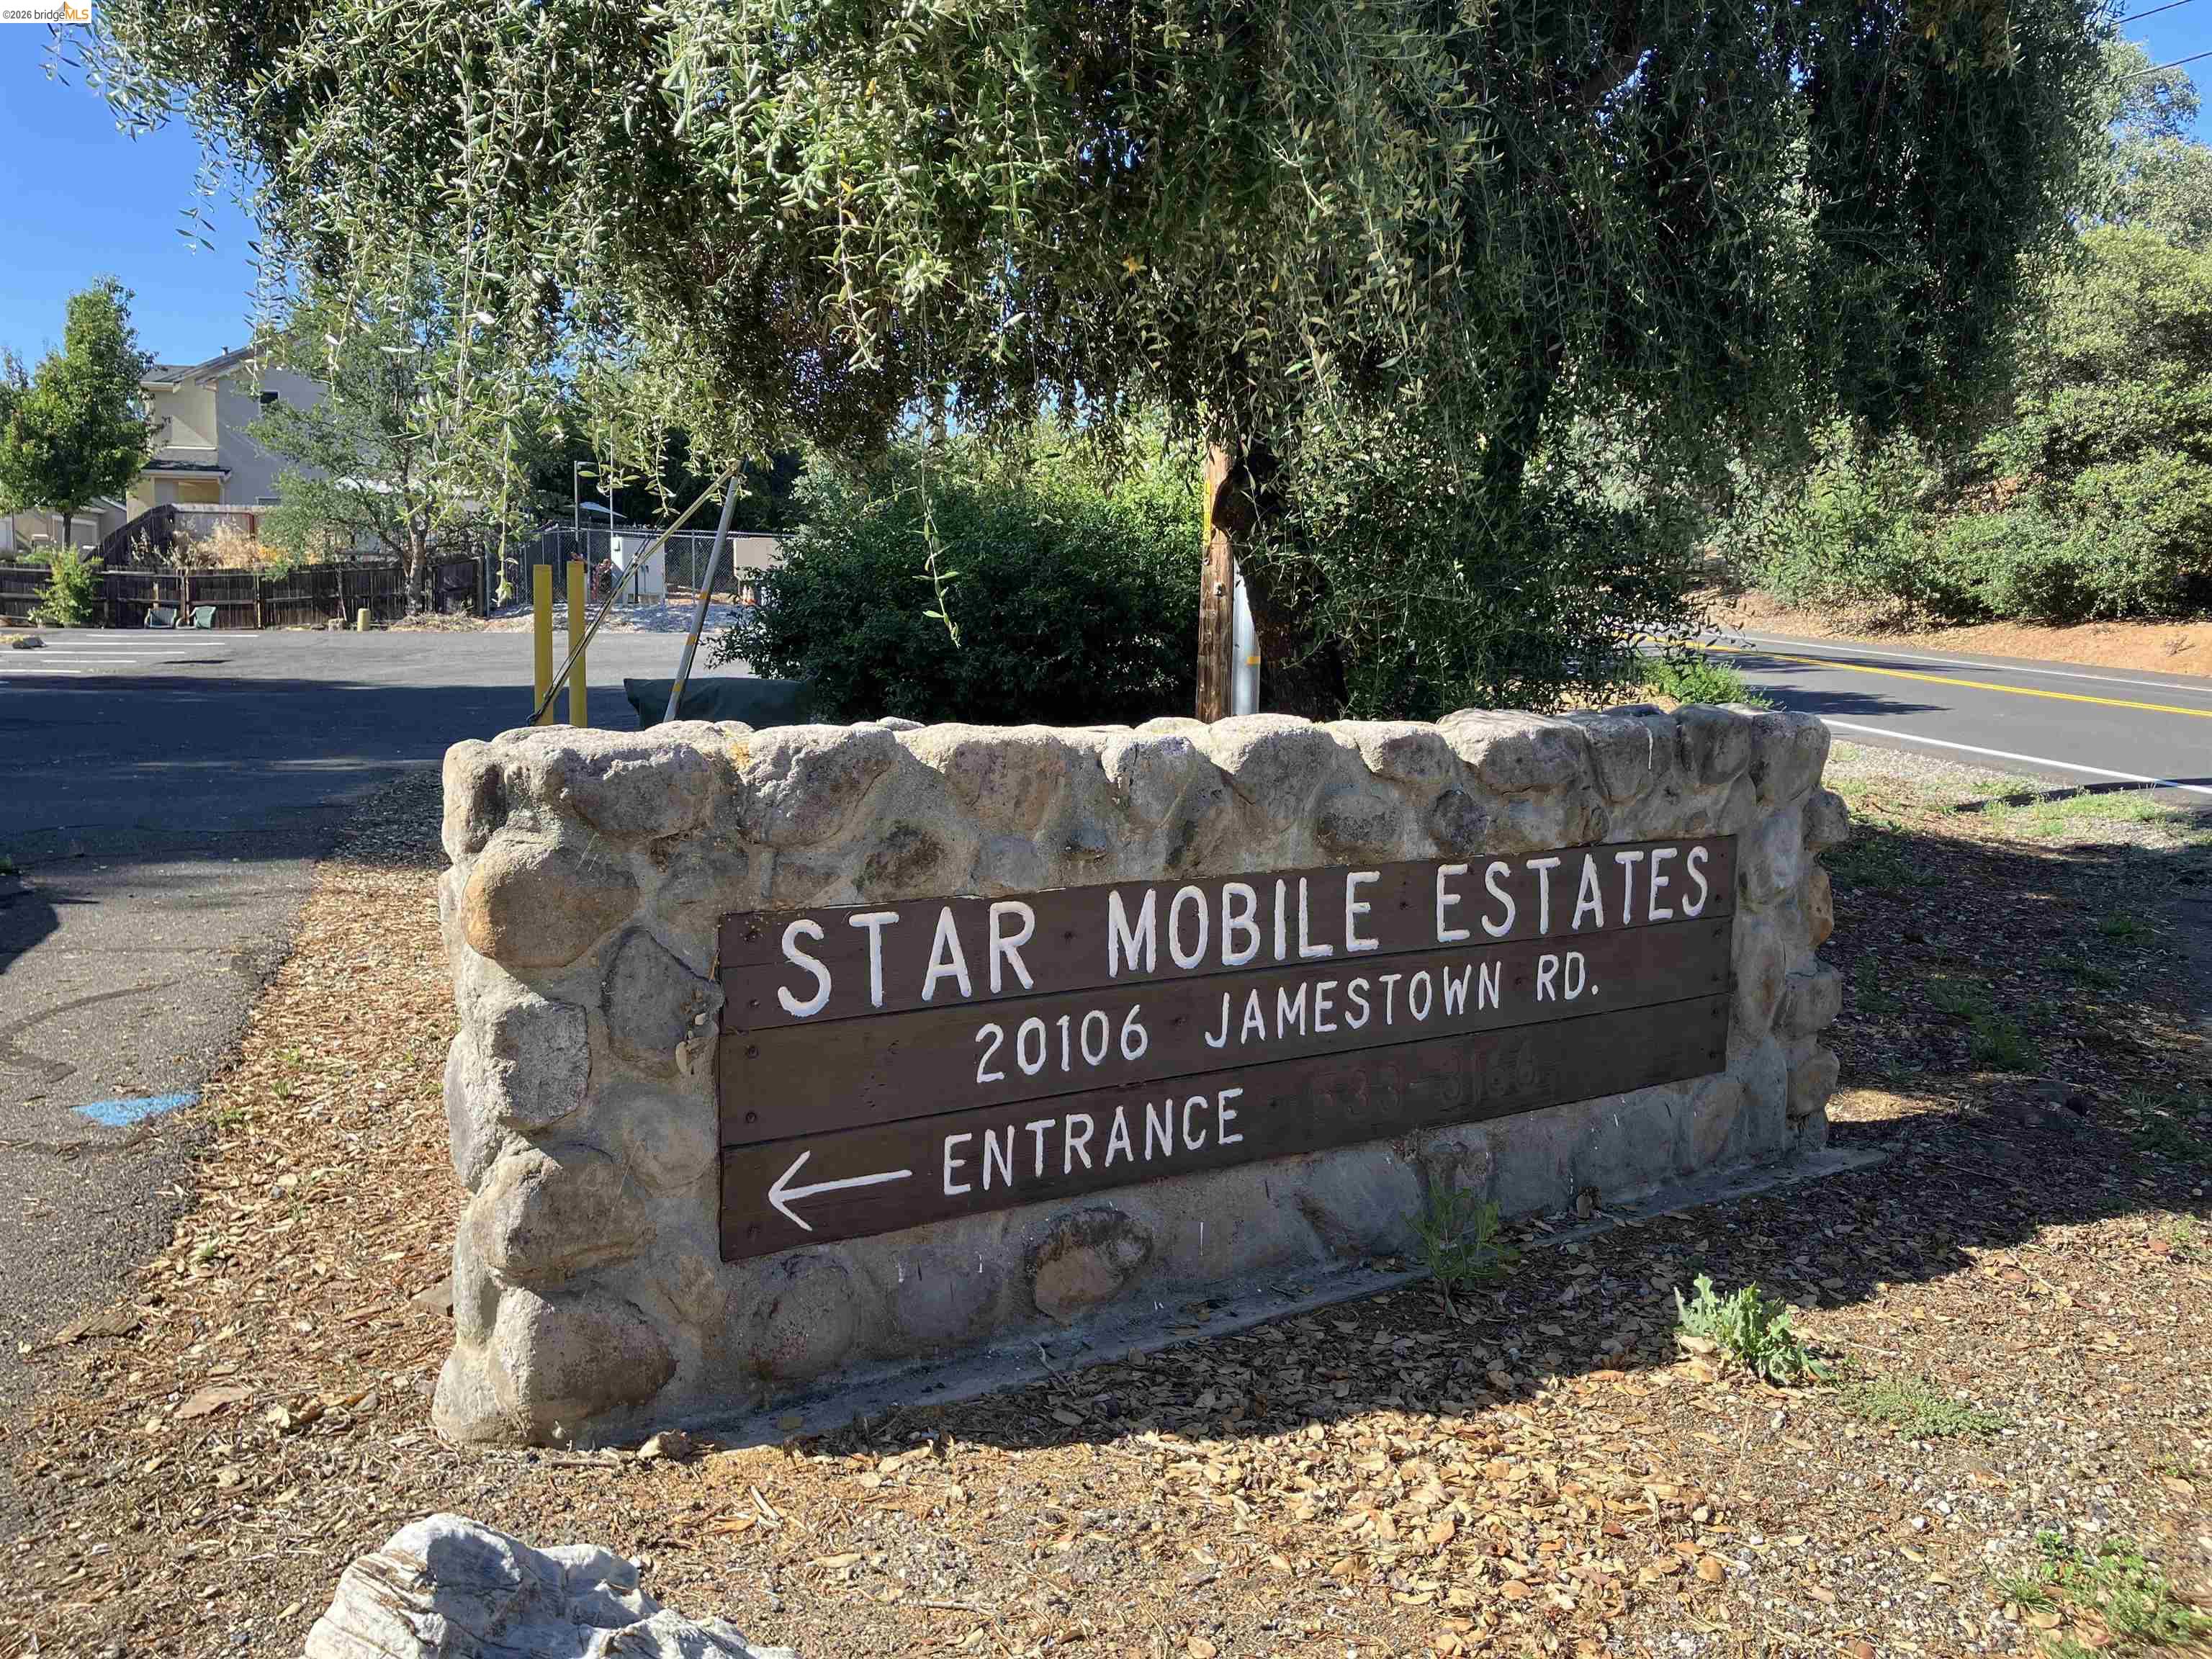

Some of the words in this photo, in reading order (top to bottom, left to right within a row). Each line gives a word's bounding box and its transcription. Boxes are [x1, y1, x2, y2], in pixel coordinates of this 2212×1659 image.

[775, 900, 1036, 1018] STAR
[1107, 870, 1381, 979] MOBILE
[1435, 845, 1709, 943] ESTATES
[974, 1003, 1149, 1084] 20106
[1203, 960, 1502, 1049] JAMESTOWN
[1535, 950, 1599, 1002] RD.
[943, 1087, 1244, 1196] ENTRANCE
